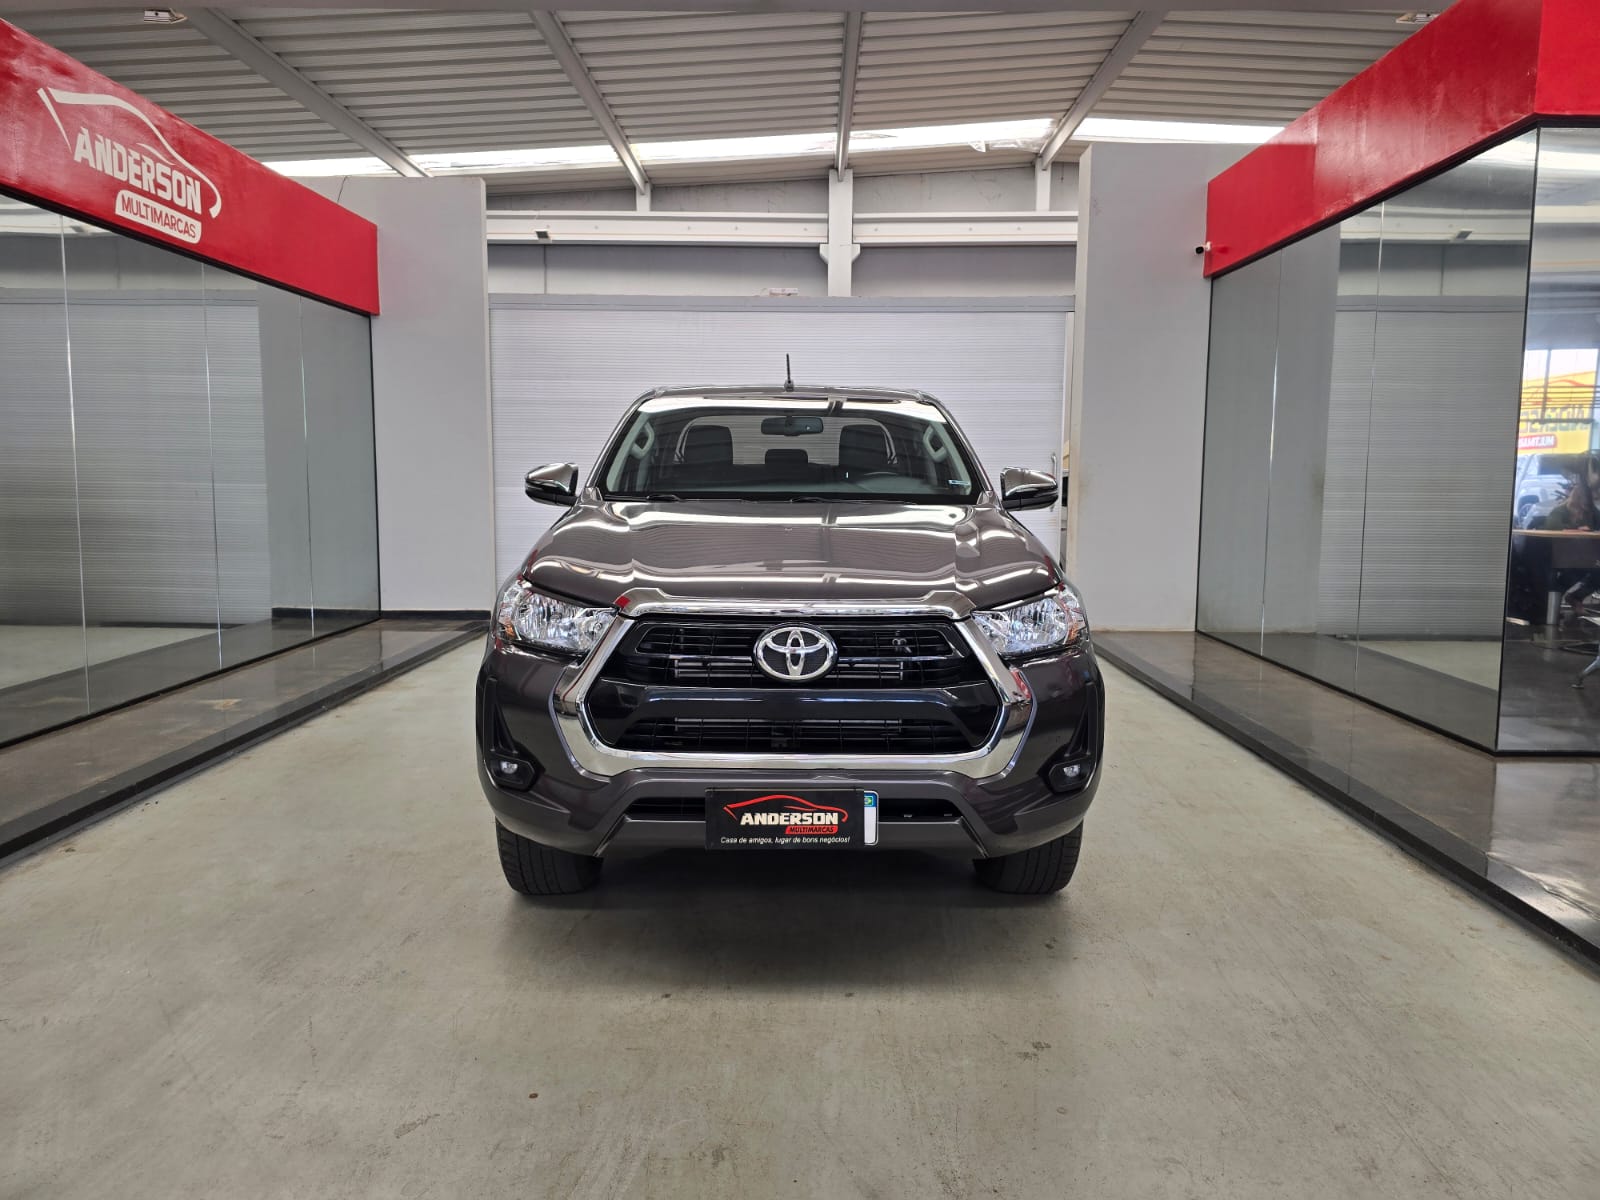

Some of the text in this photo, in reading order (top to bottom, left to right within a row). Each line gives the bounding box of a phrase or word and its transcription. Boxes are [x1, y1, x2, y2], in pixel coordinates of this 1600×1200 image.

[74, 127, 201, 214] ANDERSON
[121, 196, 196, 239] MULTIMARCAS
[740, 812, 839, 825] ANDERSON
[720, 836, 850, 845] Casa de amigos, lugar de bons negócios!
